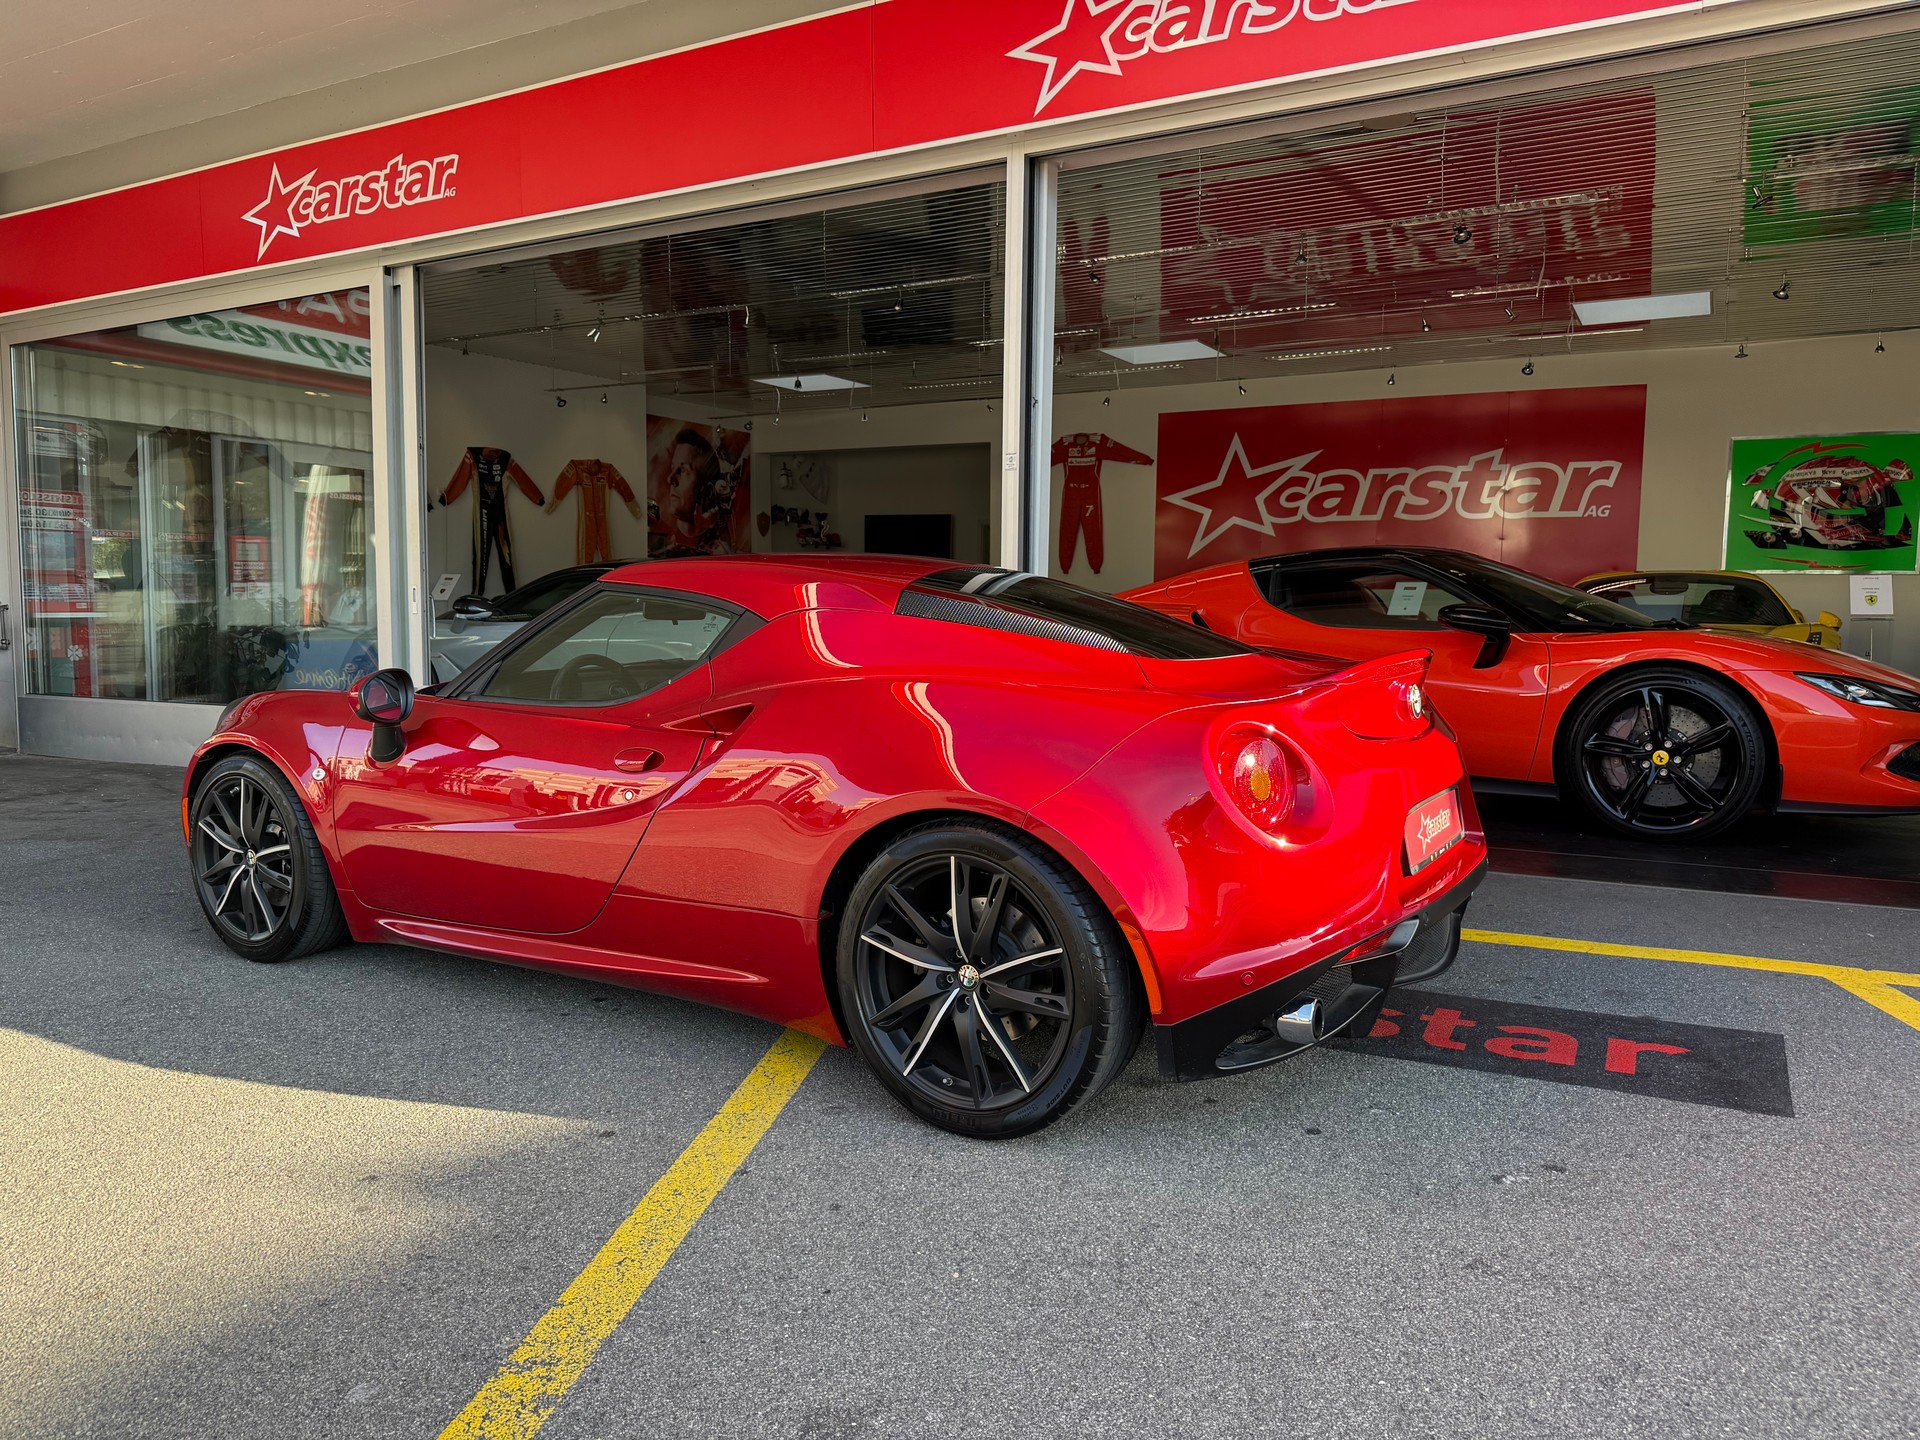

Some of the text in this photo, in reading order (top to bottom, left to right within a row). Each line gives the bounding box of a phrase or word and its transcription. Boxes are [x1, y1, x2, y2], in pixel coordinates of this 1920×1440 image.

[288, 153, 459, 228] carstar AG
[1255, 447, 1622, 524] carstar AG
[1086, 504, 1095, 517] 7
[1426, 808, 1451, 840] carstar
[1046, 1077, 1072, 1110] OUTSIDE
